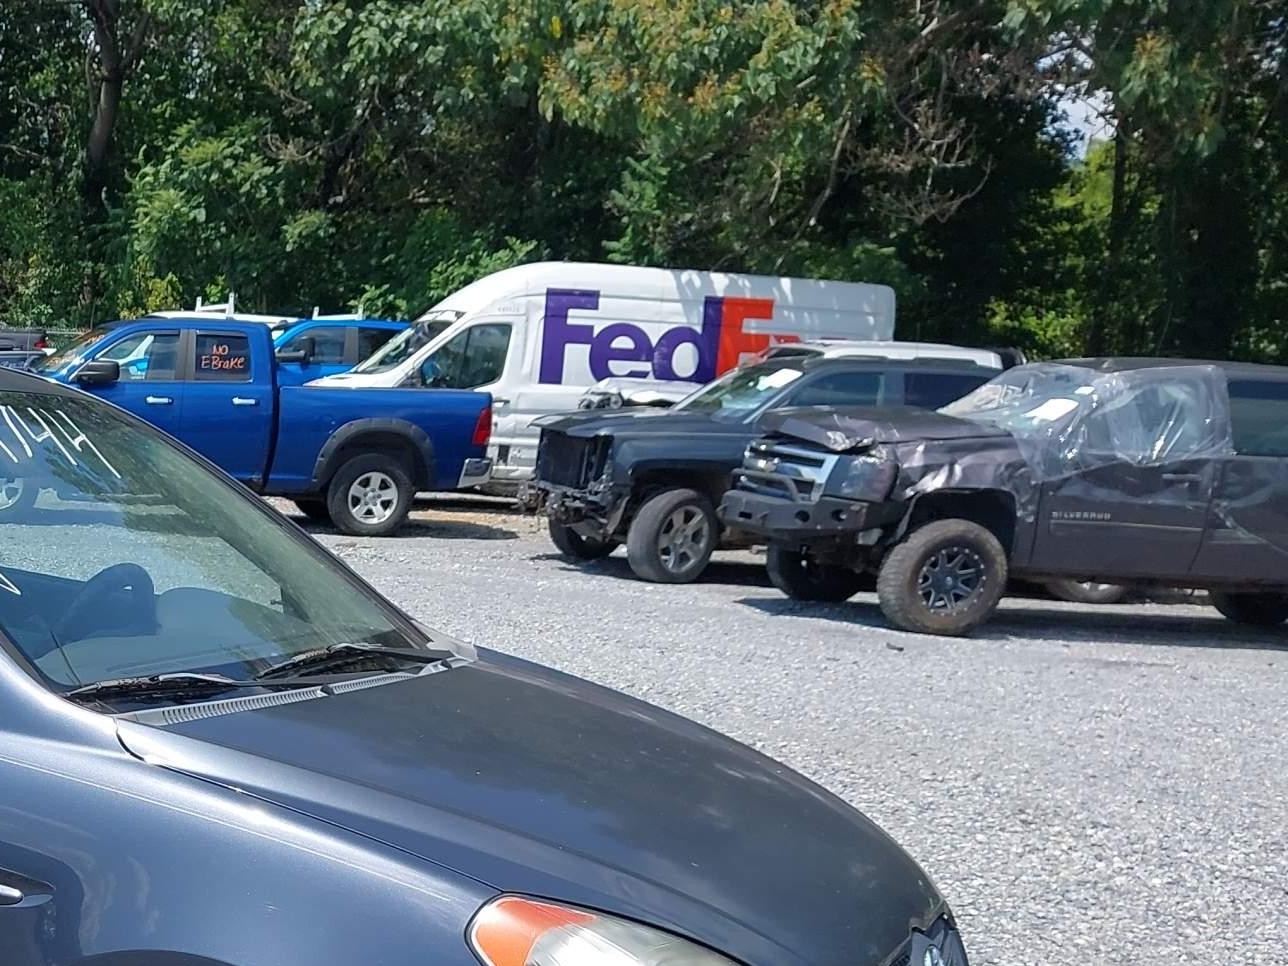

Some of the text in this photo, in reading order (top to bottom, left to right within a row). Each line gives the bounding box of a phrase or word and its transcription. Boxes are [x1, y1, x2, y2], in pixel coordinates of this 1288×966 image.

[539, 289, 824, 385] FedE
[212, 344, 229, 355] NO
[201, 355, 210, 369] E
